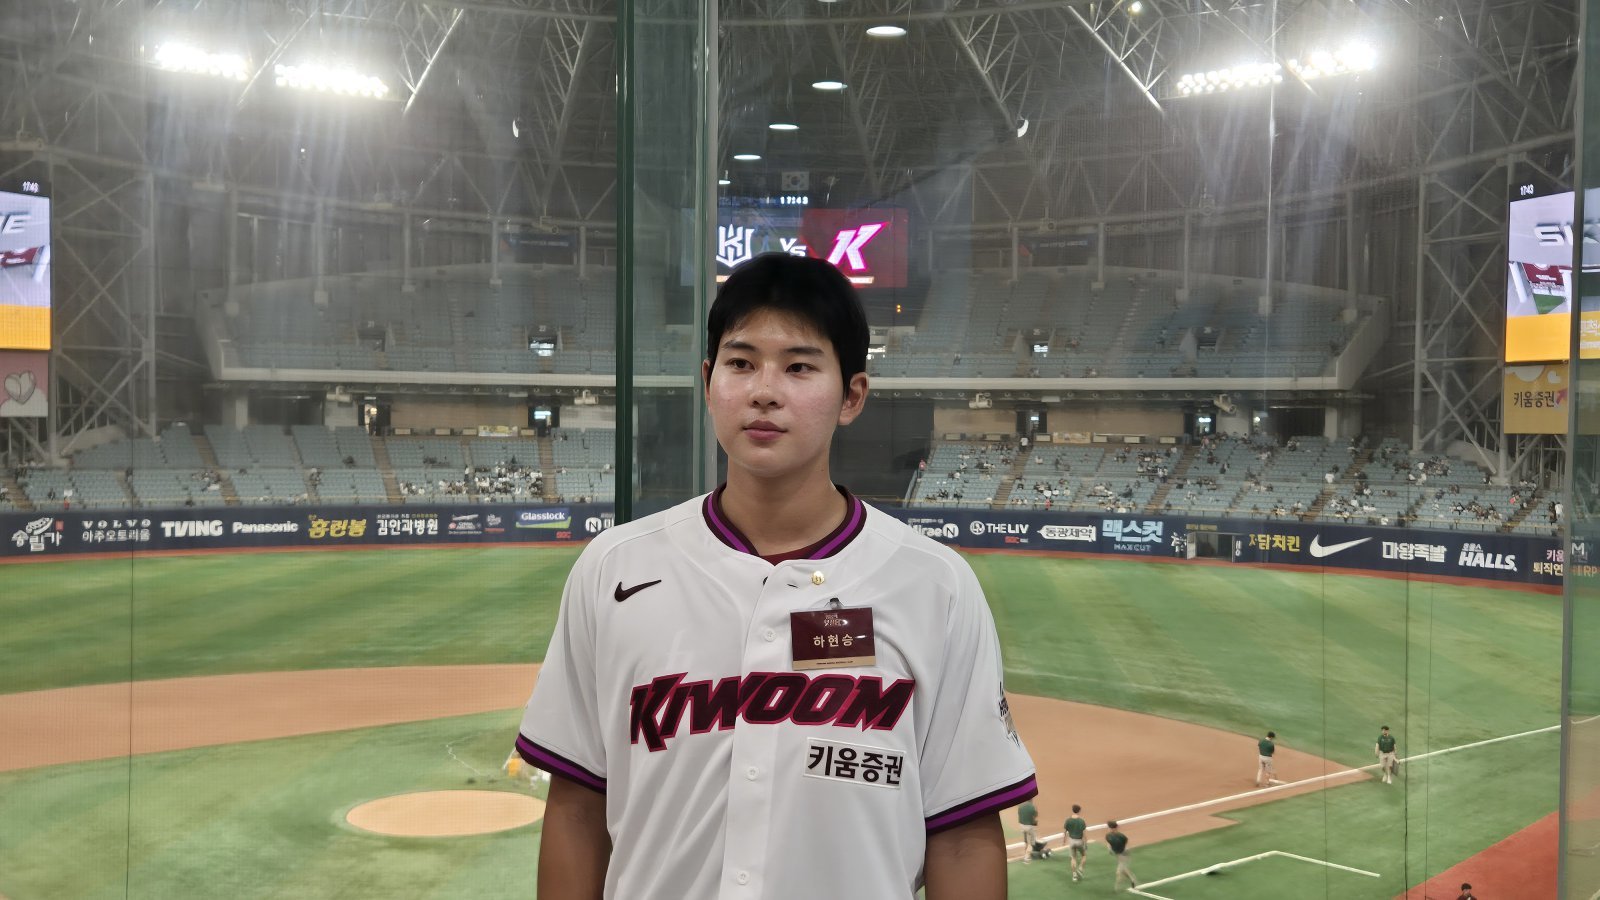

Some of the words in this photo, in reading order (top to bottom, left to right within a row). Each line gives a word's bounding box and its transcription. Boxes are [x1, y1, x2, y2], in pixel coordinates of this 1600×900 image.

[1513, 391, 1555, 408] 키움증권
[82, 519, 151, 529] VOLVO
[521, 511, 566, 521] Glasslock
[160, 519, 223, 538] TVING
[232, 521, 299, 534] Panasonic
[376, 518, 438, 536] 김안과병원
[911, 523, 959, 539] iraeN
[985, 523, 1007, 534] THE
[1007, 523, 1030, 534] LIV
[1045, 526, 1093, 539] 동광제약
[1102, 519, 1164, 543] 맥스컷
[1458, 551, 1518, 572] HALLS
[1533, 561, 1564, 577] 퇴직연
[813, 633, 854, 649] 하현승
[630, 671, 916, 753] KIWOOM
[807, 745, 904, 785] 키움증권
